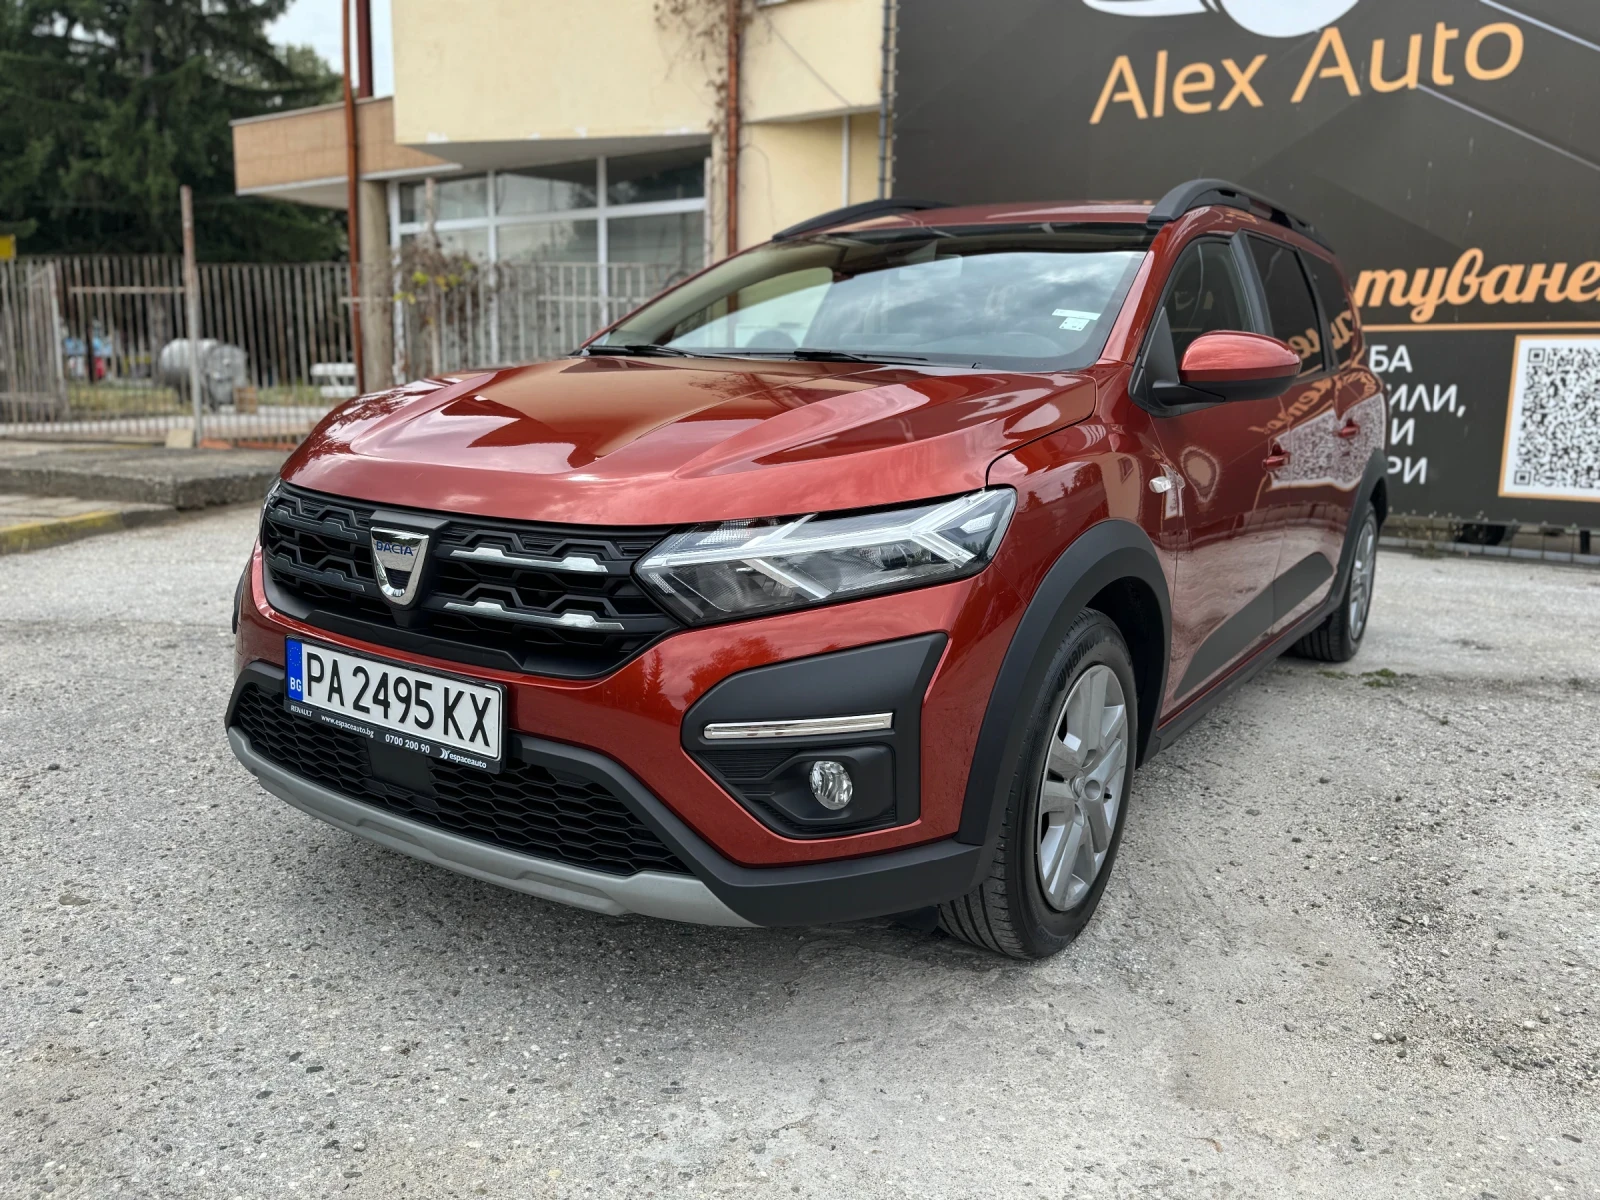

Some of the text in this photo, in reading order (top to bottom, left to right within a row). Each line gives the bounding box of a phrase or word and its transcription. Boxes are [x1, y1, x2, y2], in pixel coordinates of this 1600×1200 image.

[1089, 21, 1525, 124] Alex Auto
[1353, 247, 1600, 323] туване
[1368, 344, 1413, 373] БА
[376, 540, 414, 557] DACIA
[289, 676, 302, 692] BG
[290, 704, 487, 769] RENAULT www.espaceauto.bg 0700 200 90 espaceauto
